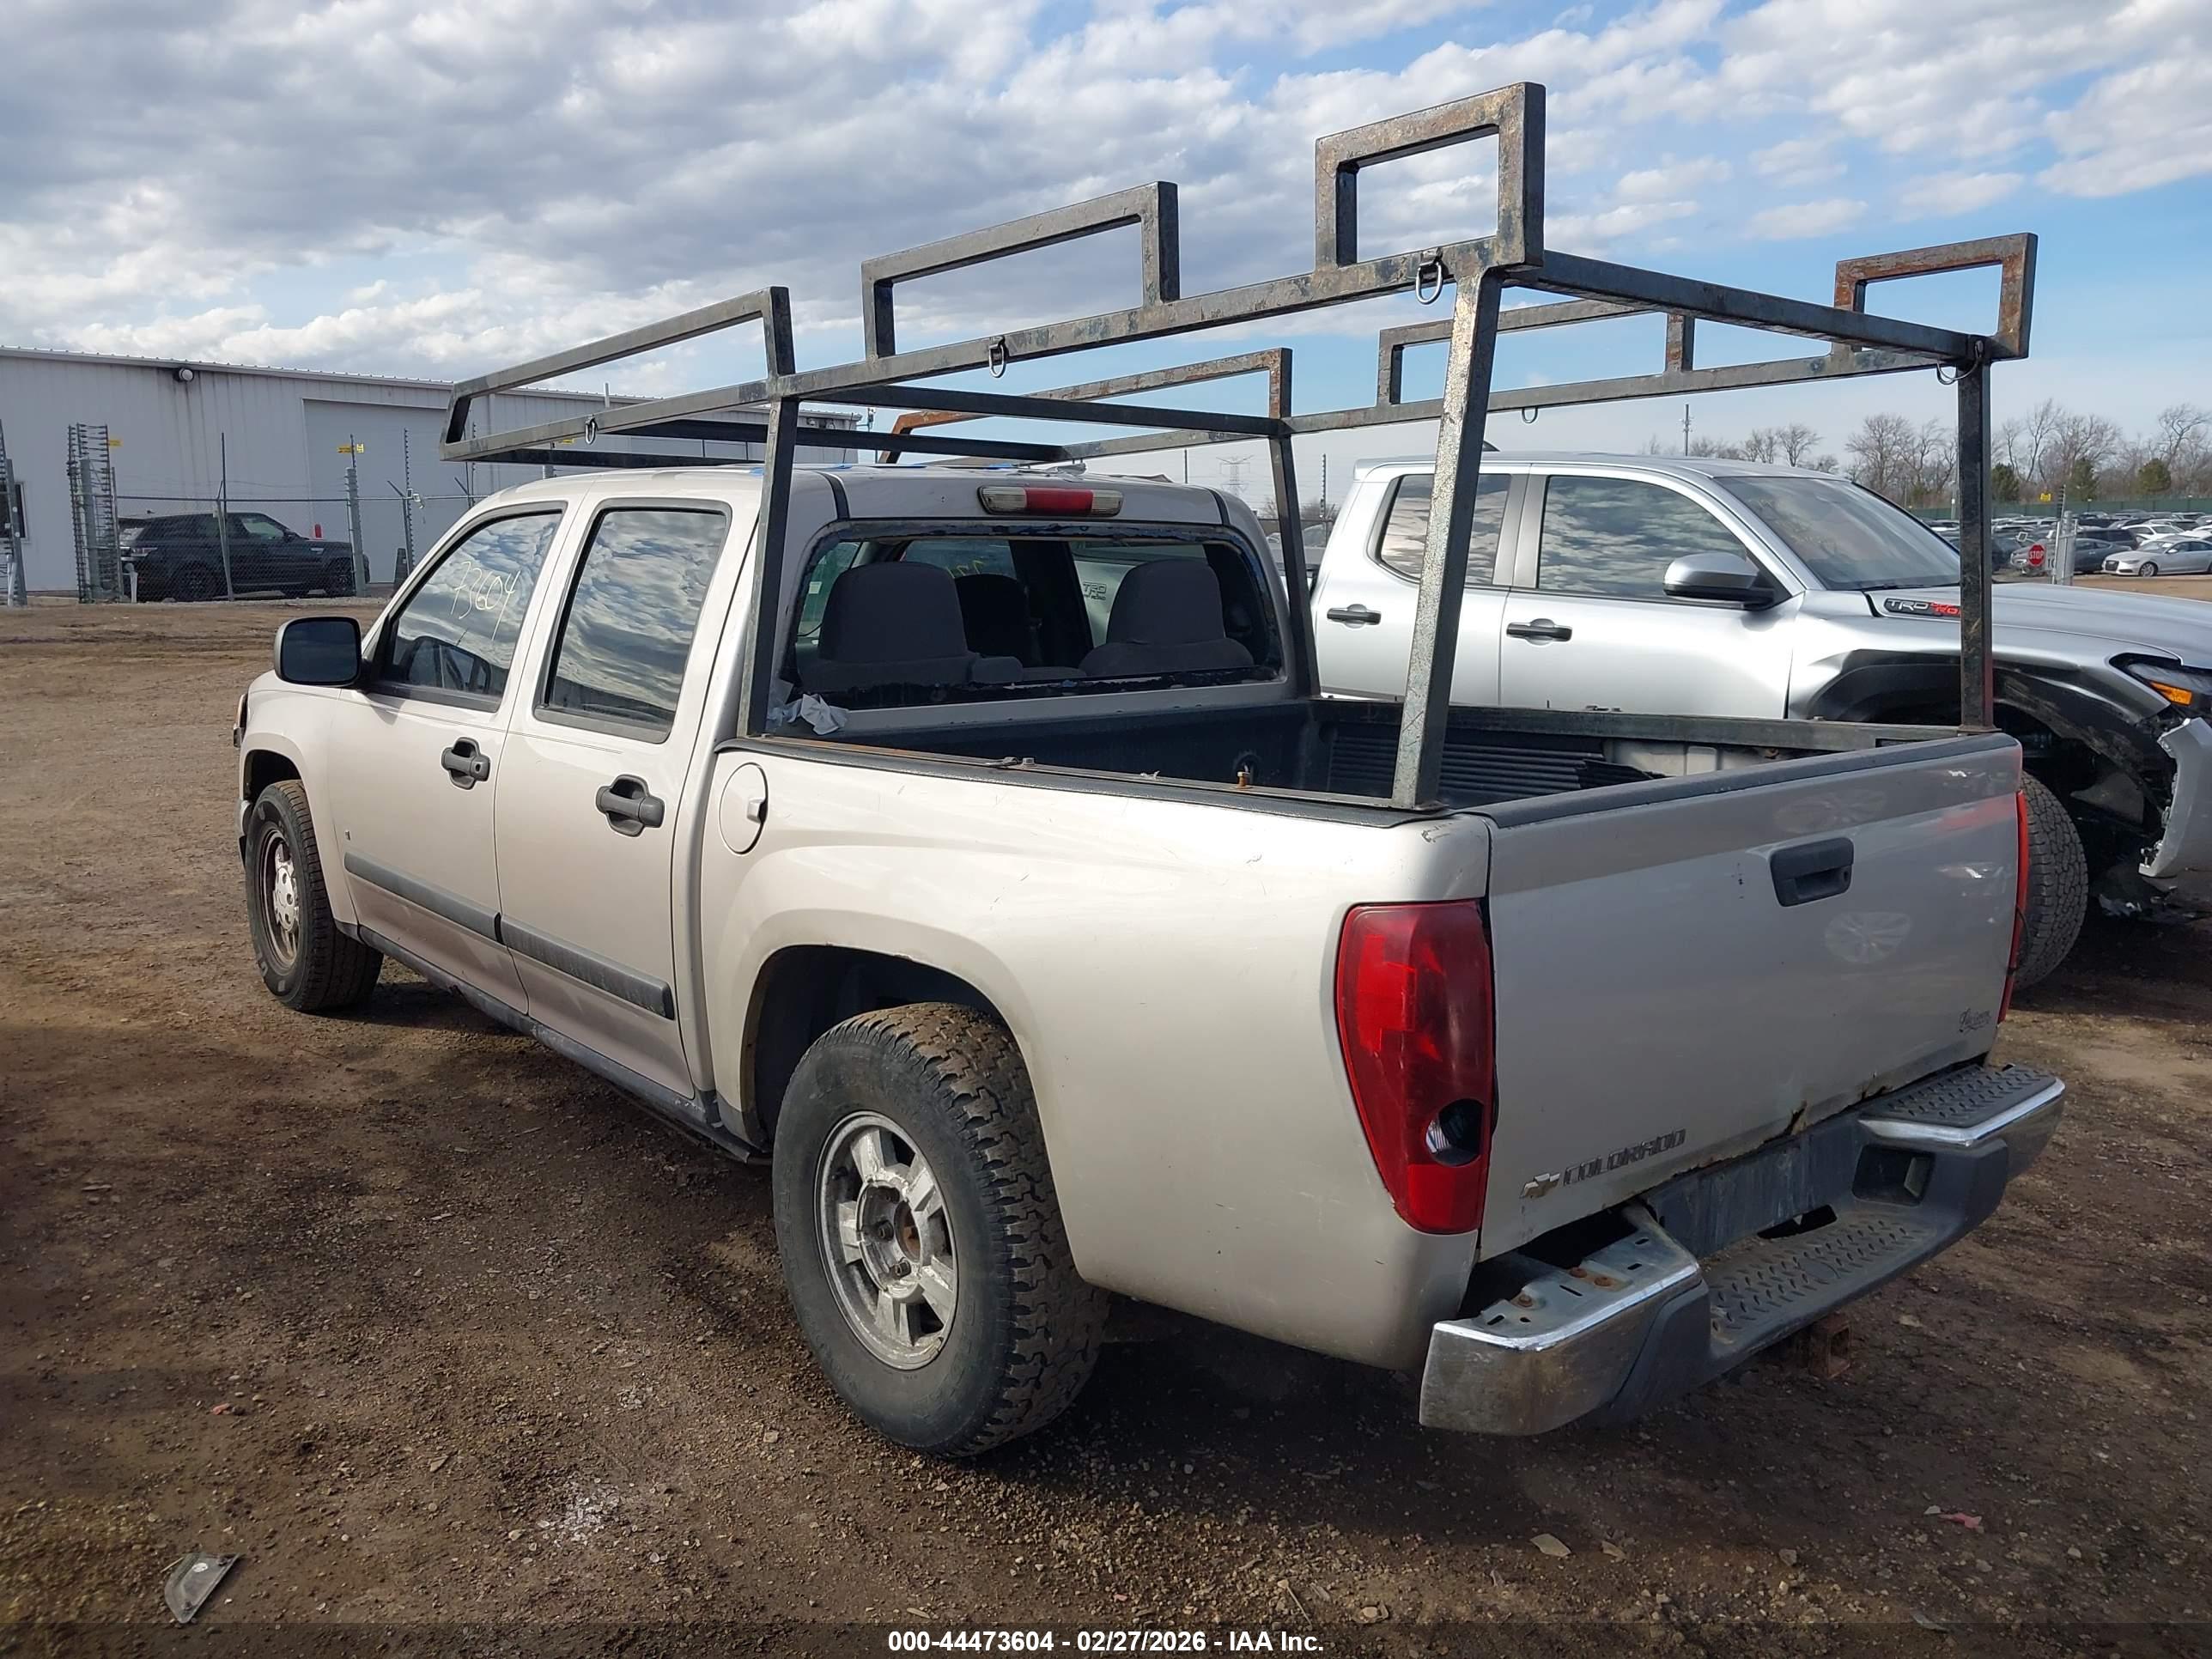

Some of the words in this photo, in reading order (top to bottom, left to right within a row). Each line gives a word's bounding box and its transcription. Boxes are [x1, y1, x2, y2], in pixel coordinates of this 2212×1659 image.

[2029, 550, 2045, 560] STOP
[450, 561, 521, 642] 73604
[1887, 599, 1929, 611] TRD
[1562, 1127, 1687, 1187] COLORADO
